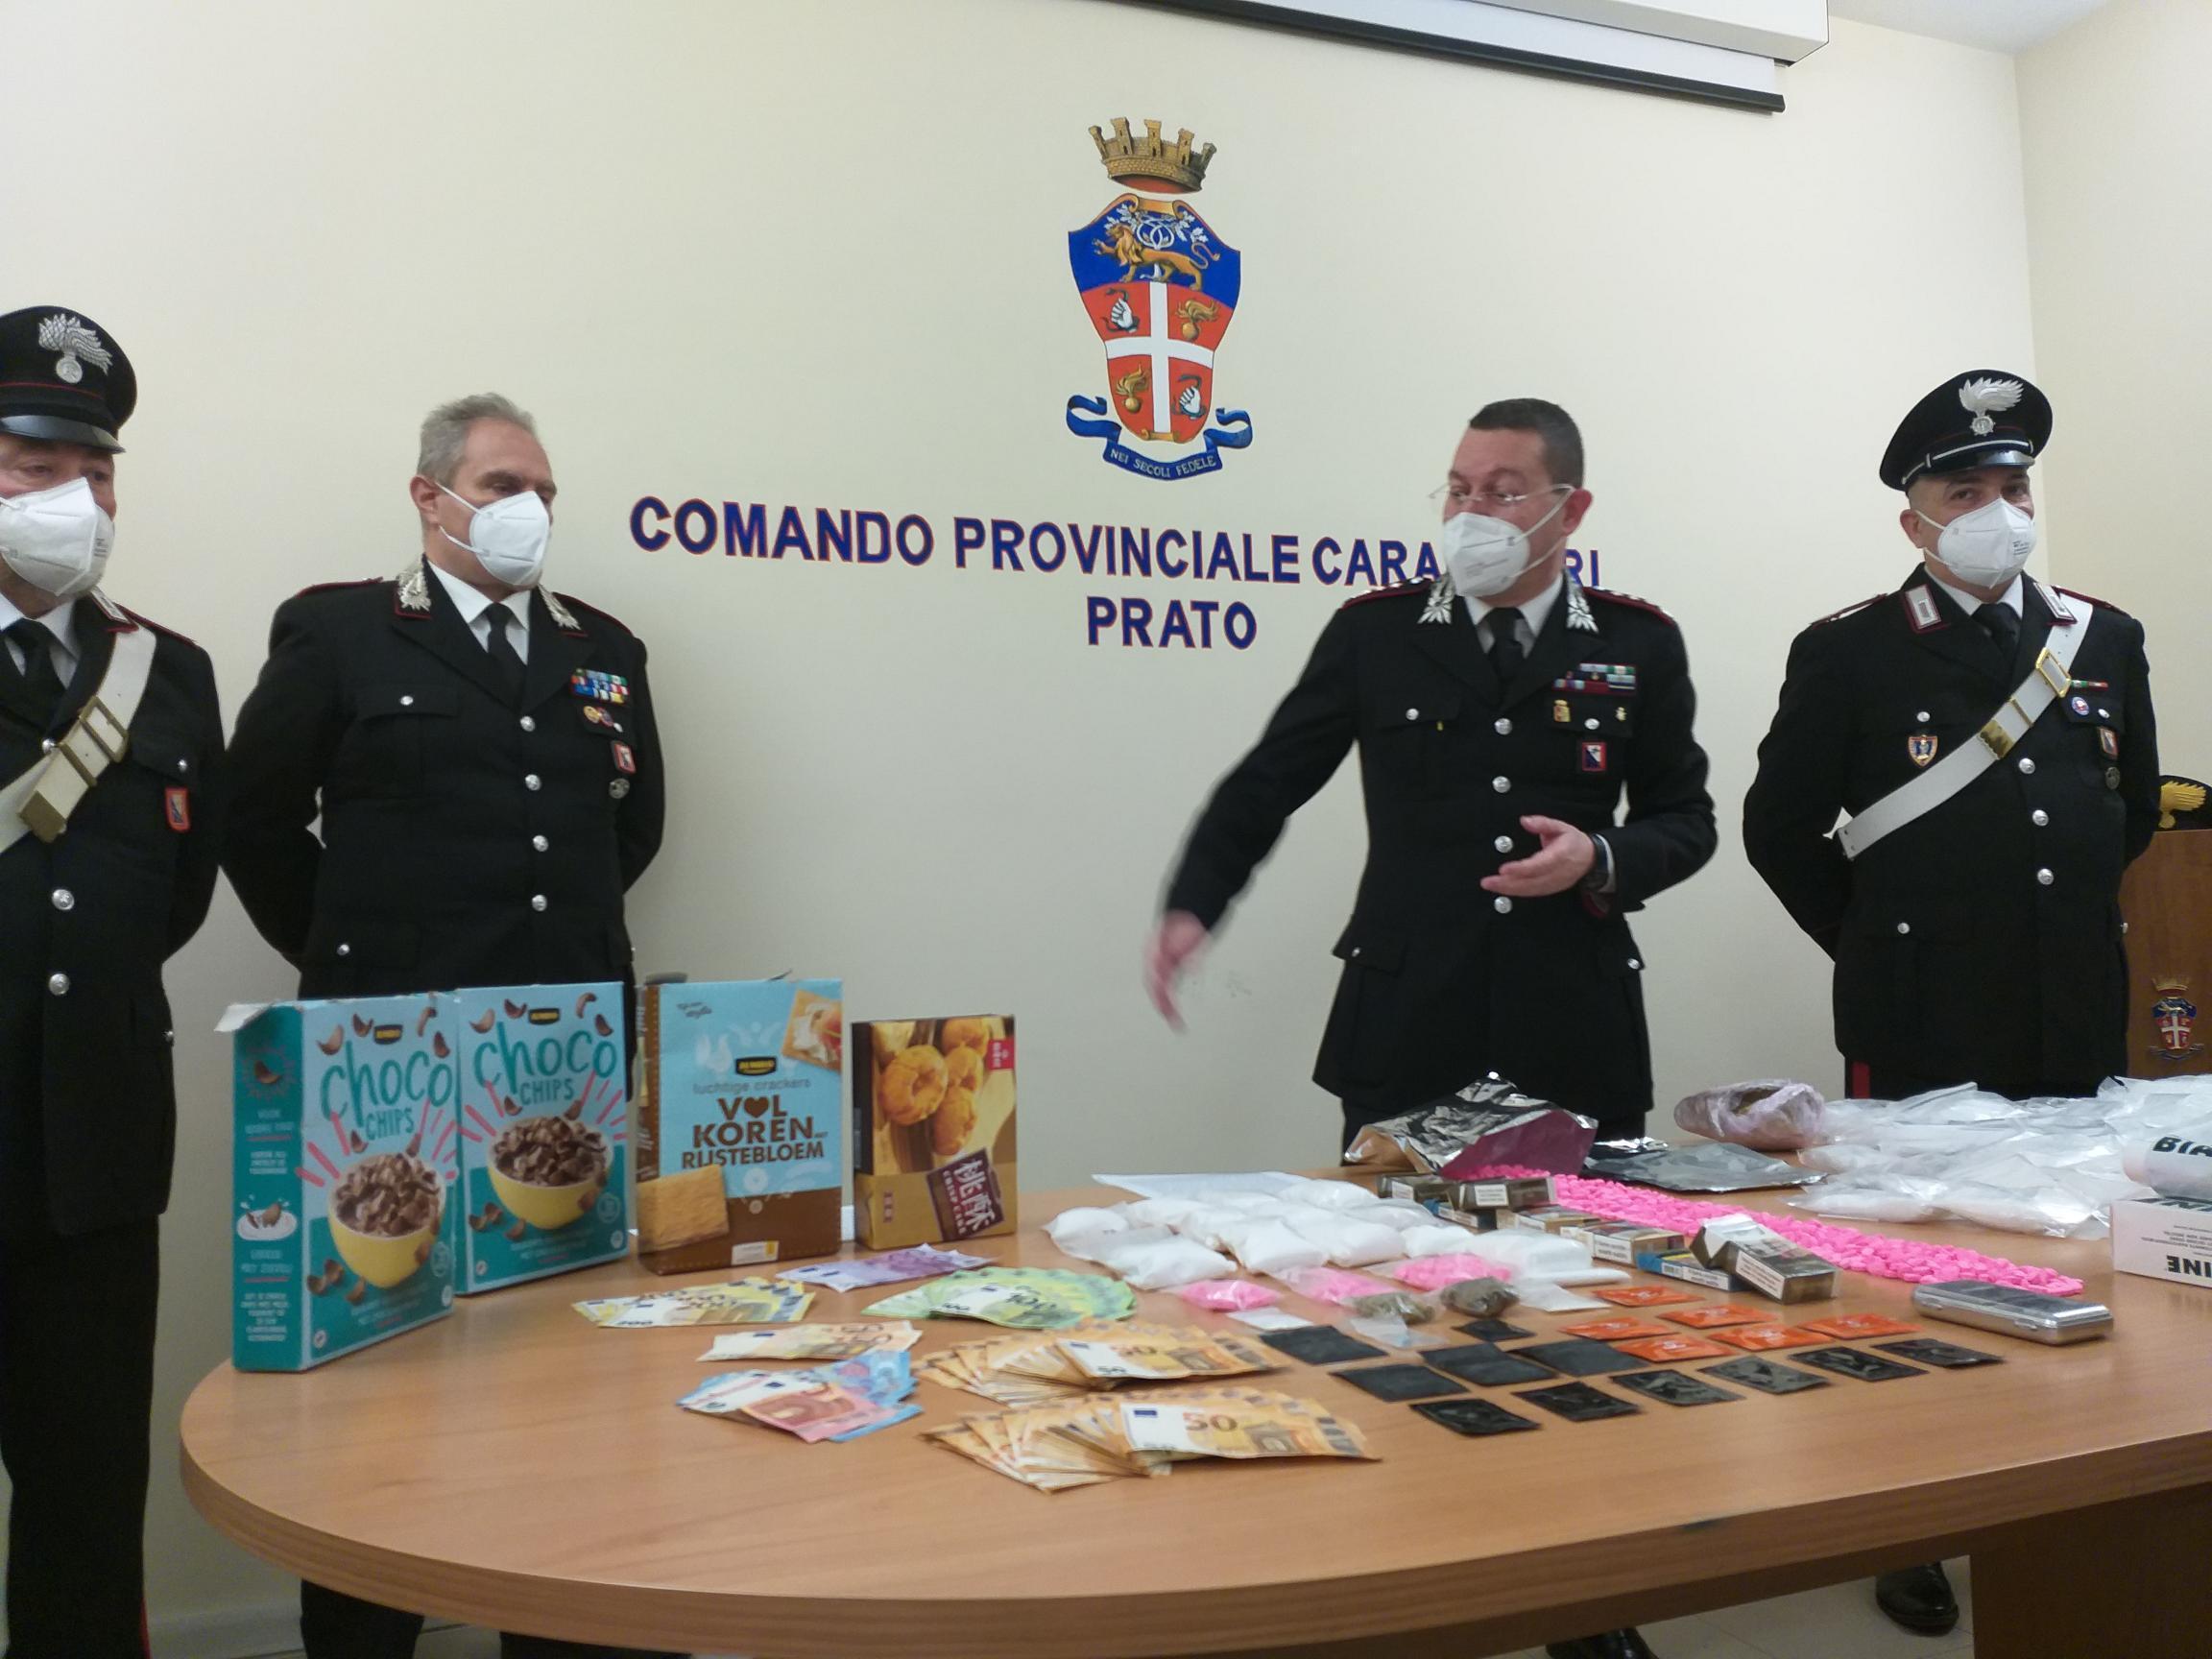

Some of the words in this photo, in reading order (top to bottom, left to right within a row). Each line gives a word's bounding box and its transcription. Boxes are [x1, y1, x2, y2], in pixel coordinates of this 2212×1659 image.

[1110, 449, 1129, 464] NEI
[1133, 458, 1170, 477] SECOLI
[1175, 455, 1217, 476] FEDELE
[630, 496, 934, 566] COMANDO
[953, 517, 1301, 584] PROVINCIALE
[1087, 596, 1258, 650] PRATO
[519, 1077, 575, 1106] CHIPS
[366, 1107, 415, 1141] CHIPS
[692, 1116, 814, 1149] KOREN
[1183, 1411, 1238, 1431] 50
